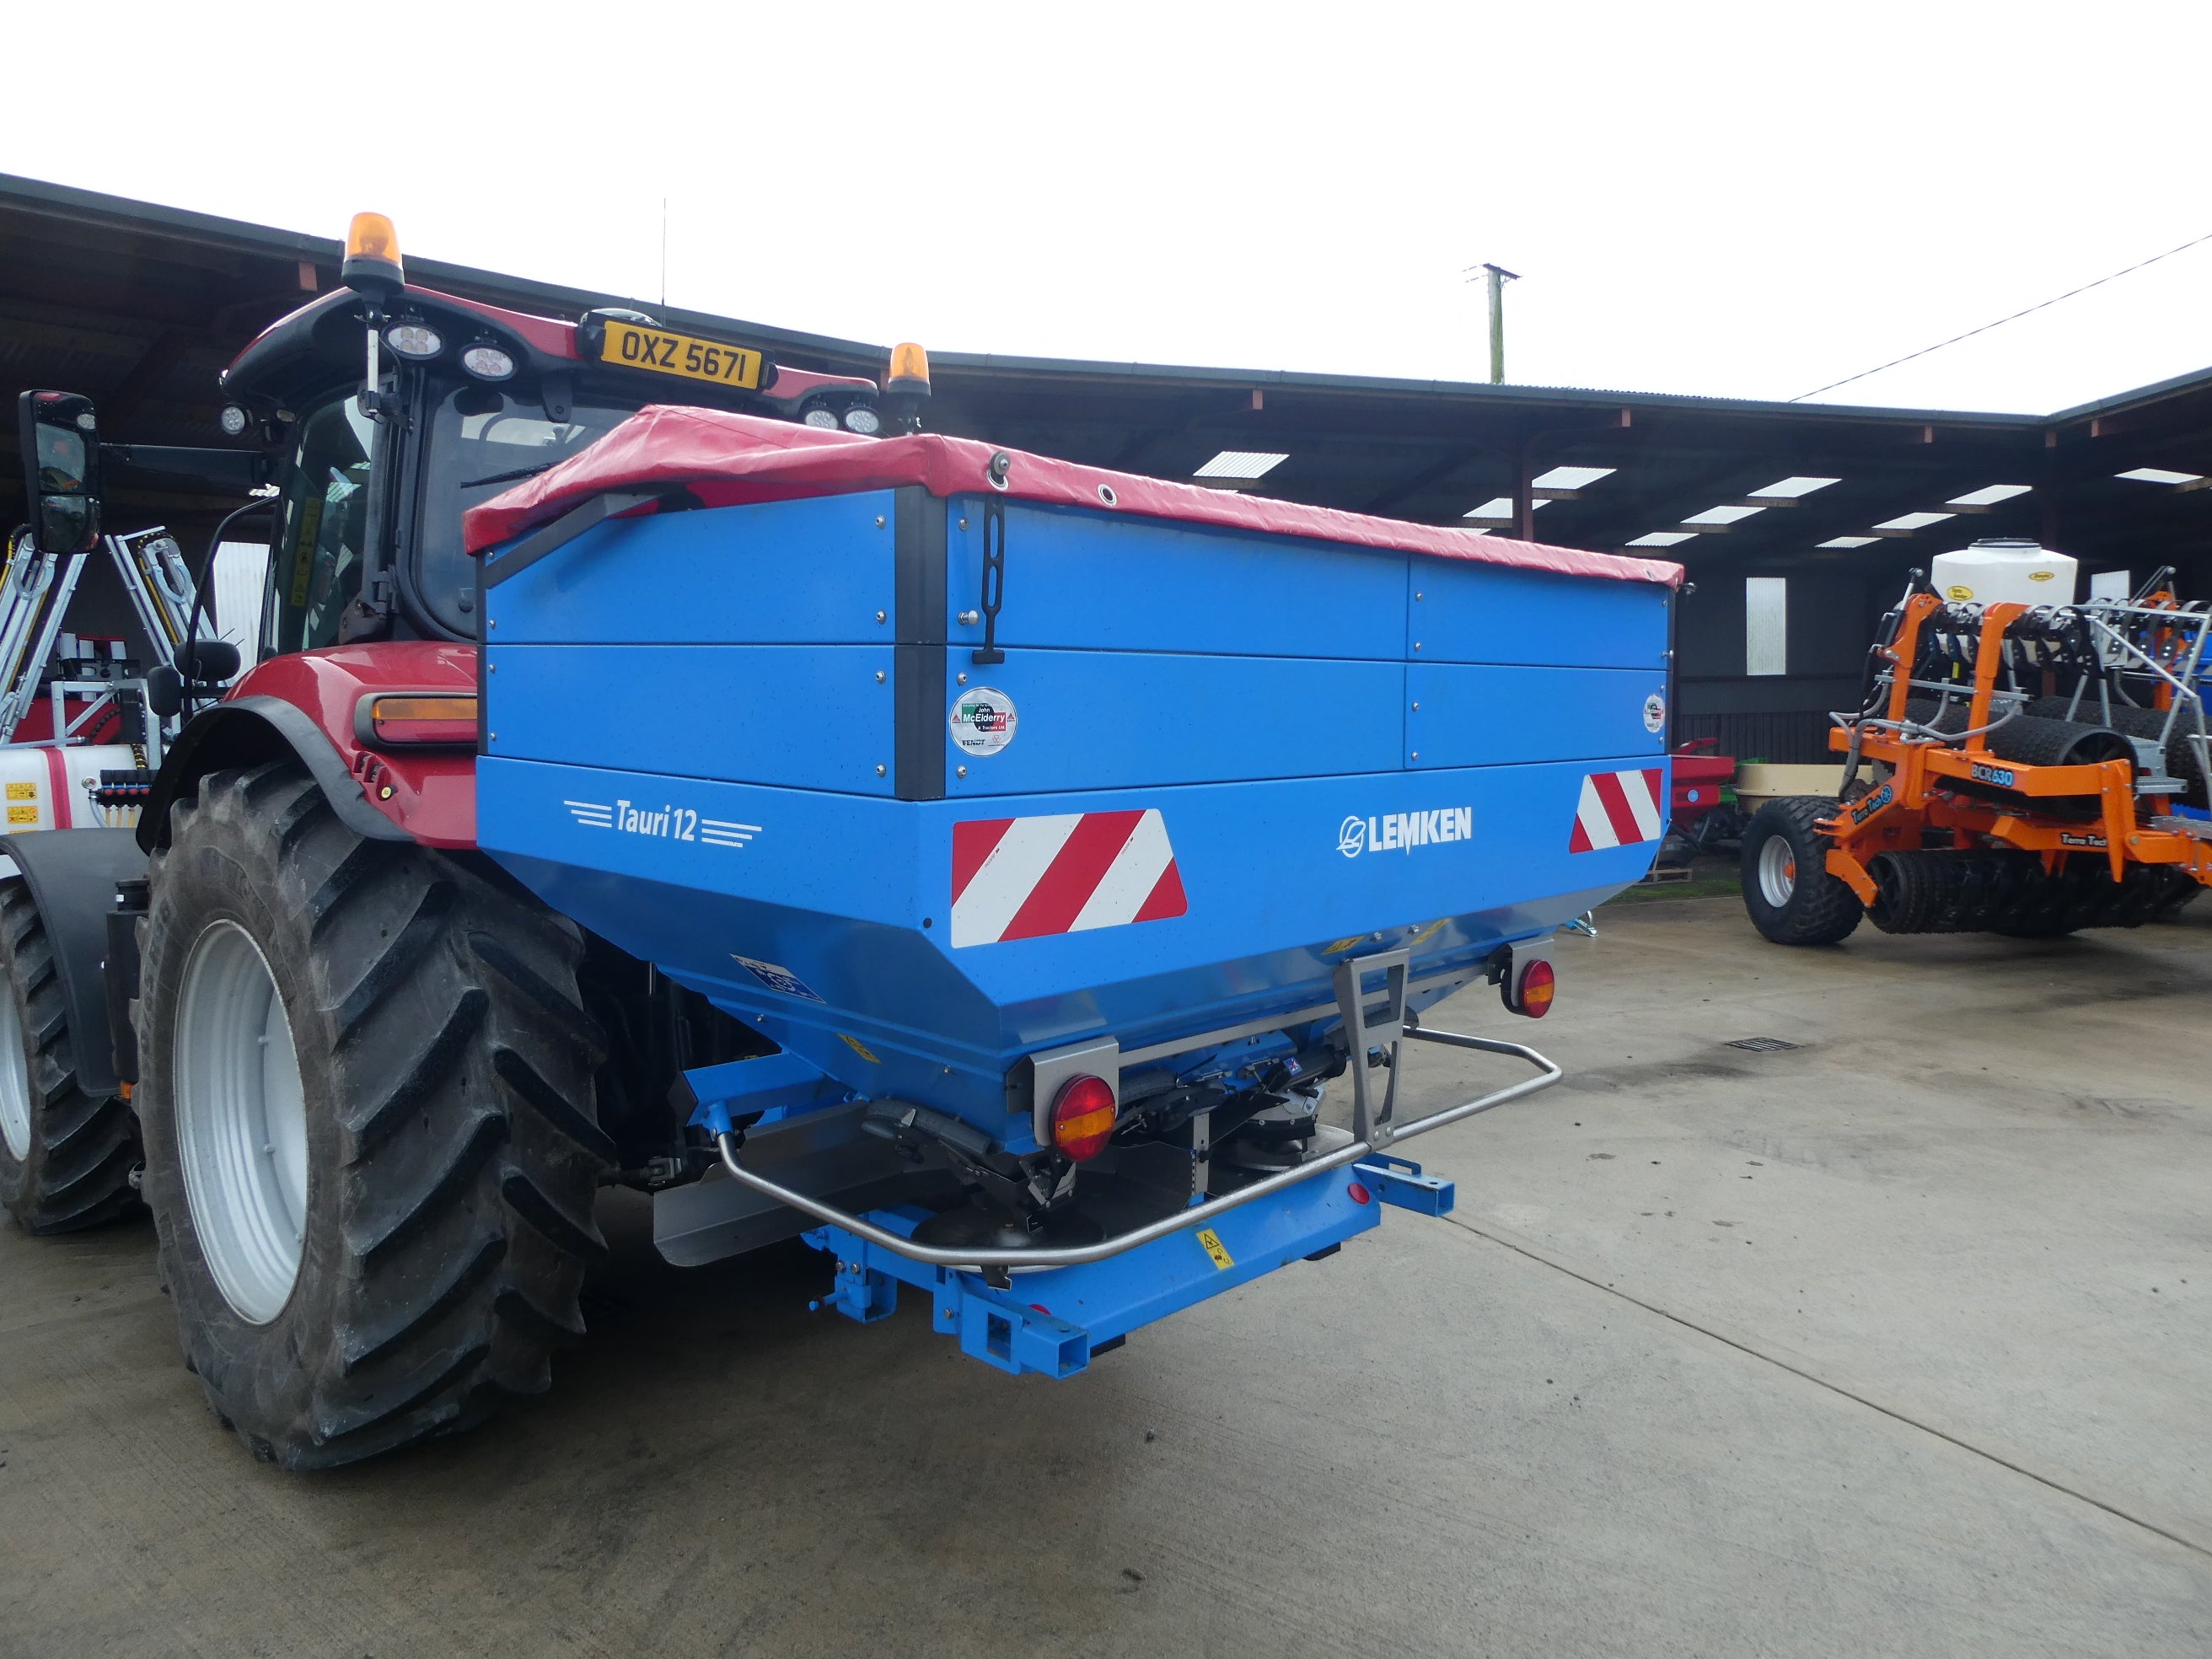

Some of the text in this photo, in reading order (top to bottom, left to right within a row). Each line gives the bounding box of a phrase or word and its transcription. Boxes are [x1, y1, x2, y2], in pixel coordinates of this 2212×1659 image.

[621, 330, 747, 382] OXZ 5671
[963, 713, 1006, 722] McElderry
[1971, 764, 2013, 787] BCR630
[617, 799, 698, 841] Tauri 12
[1368, 806, 1472, 856] LEMKEN
